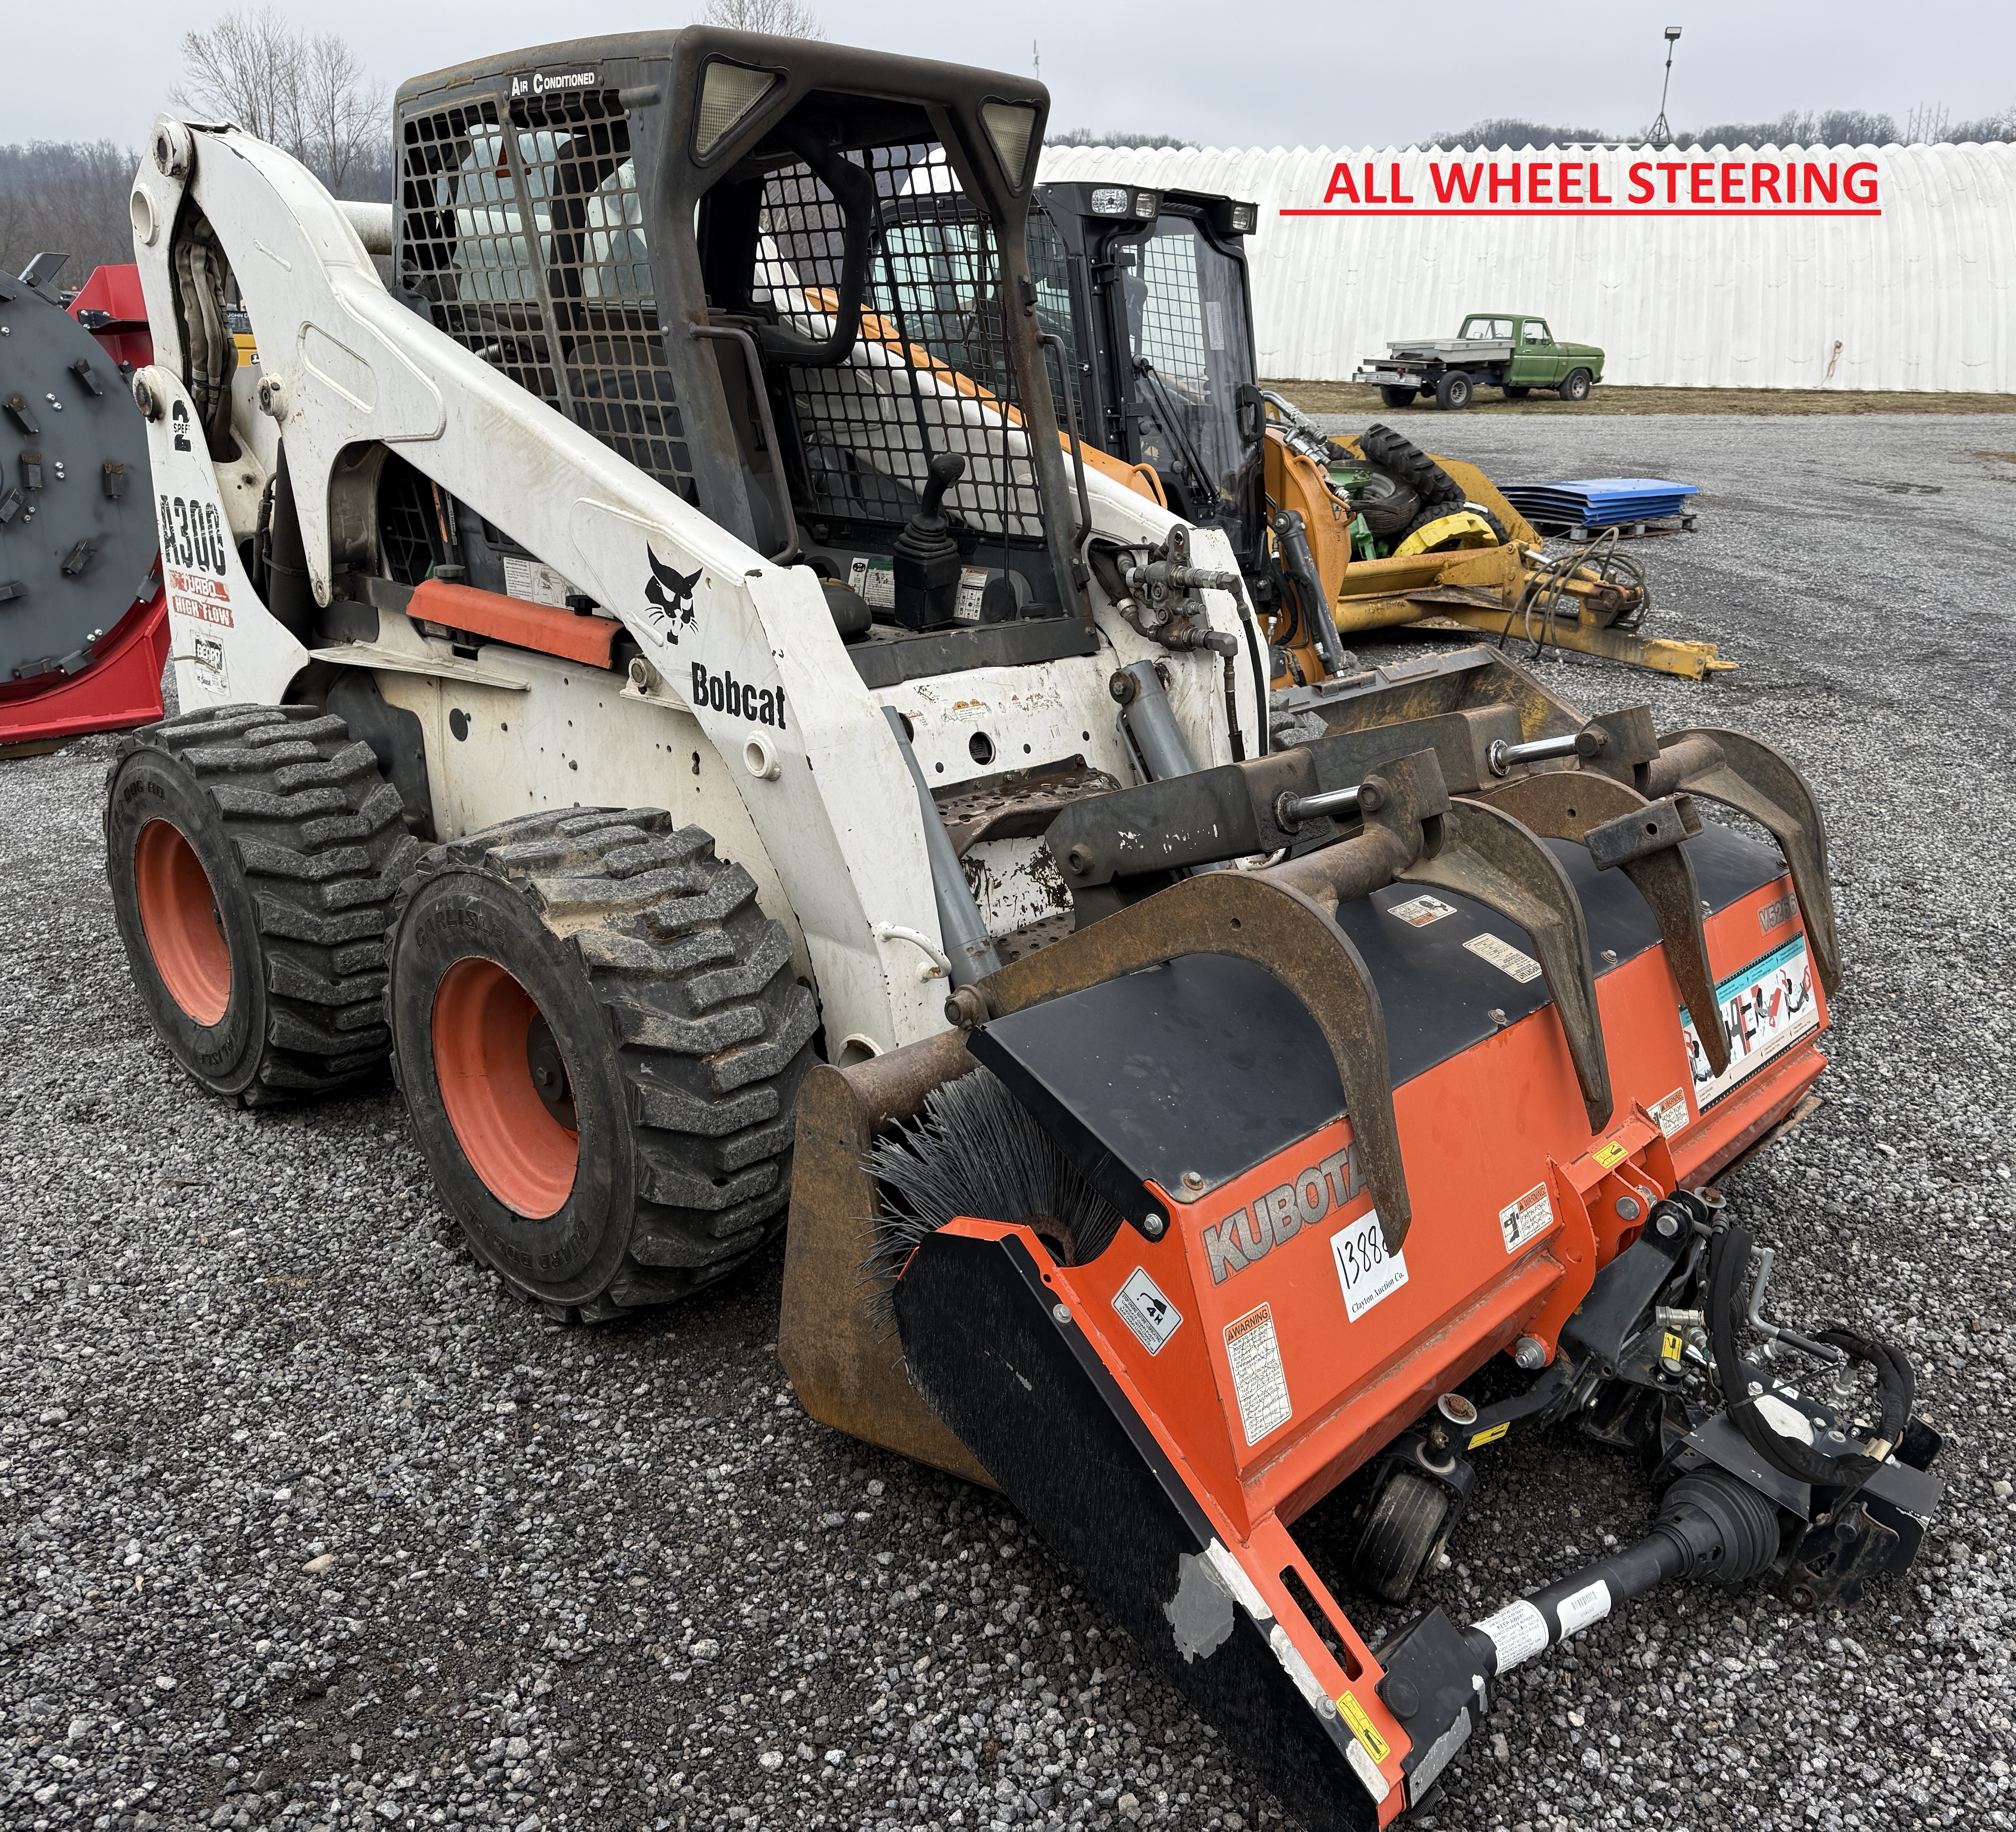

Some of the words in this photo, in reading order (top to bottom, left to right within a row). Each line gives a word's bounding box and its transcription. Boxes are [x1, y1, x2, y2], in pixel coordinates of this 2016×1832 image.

[533, 72, 594, 94] CONDITIONED
[201, 603, 230, 626] FLOW
[691, 661, 786, 730] Bobcat
[1758, 893, 1798, 931] V5266
[415, 909, 506, 950] CARLISLE
[1352, 1289, 1373, 1314] Clayton
[1374, 1276, 1394, 1300] Auction
[1394, 1272, 1405, 1287] Co.
[1233, 1308, 1268, 1336] WARNING
[1496, 1620, 1510, 1630] KEEP
